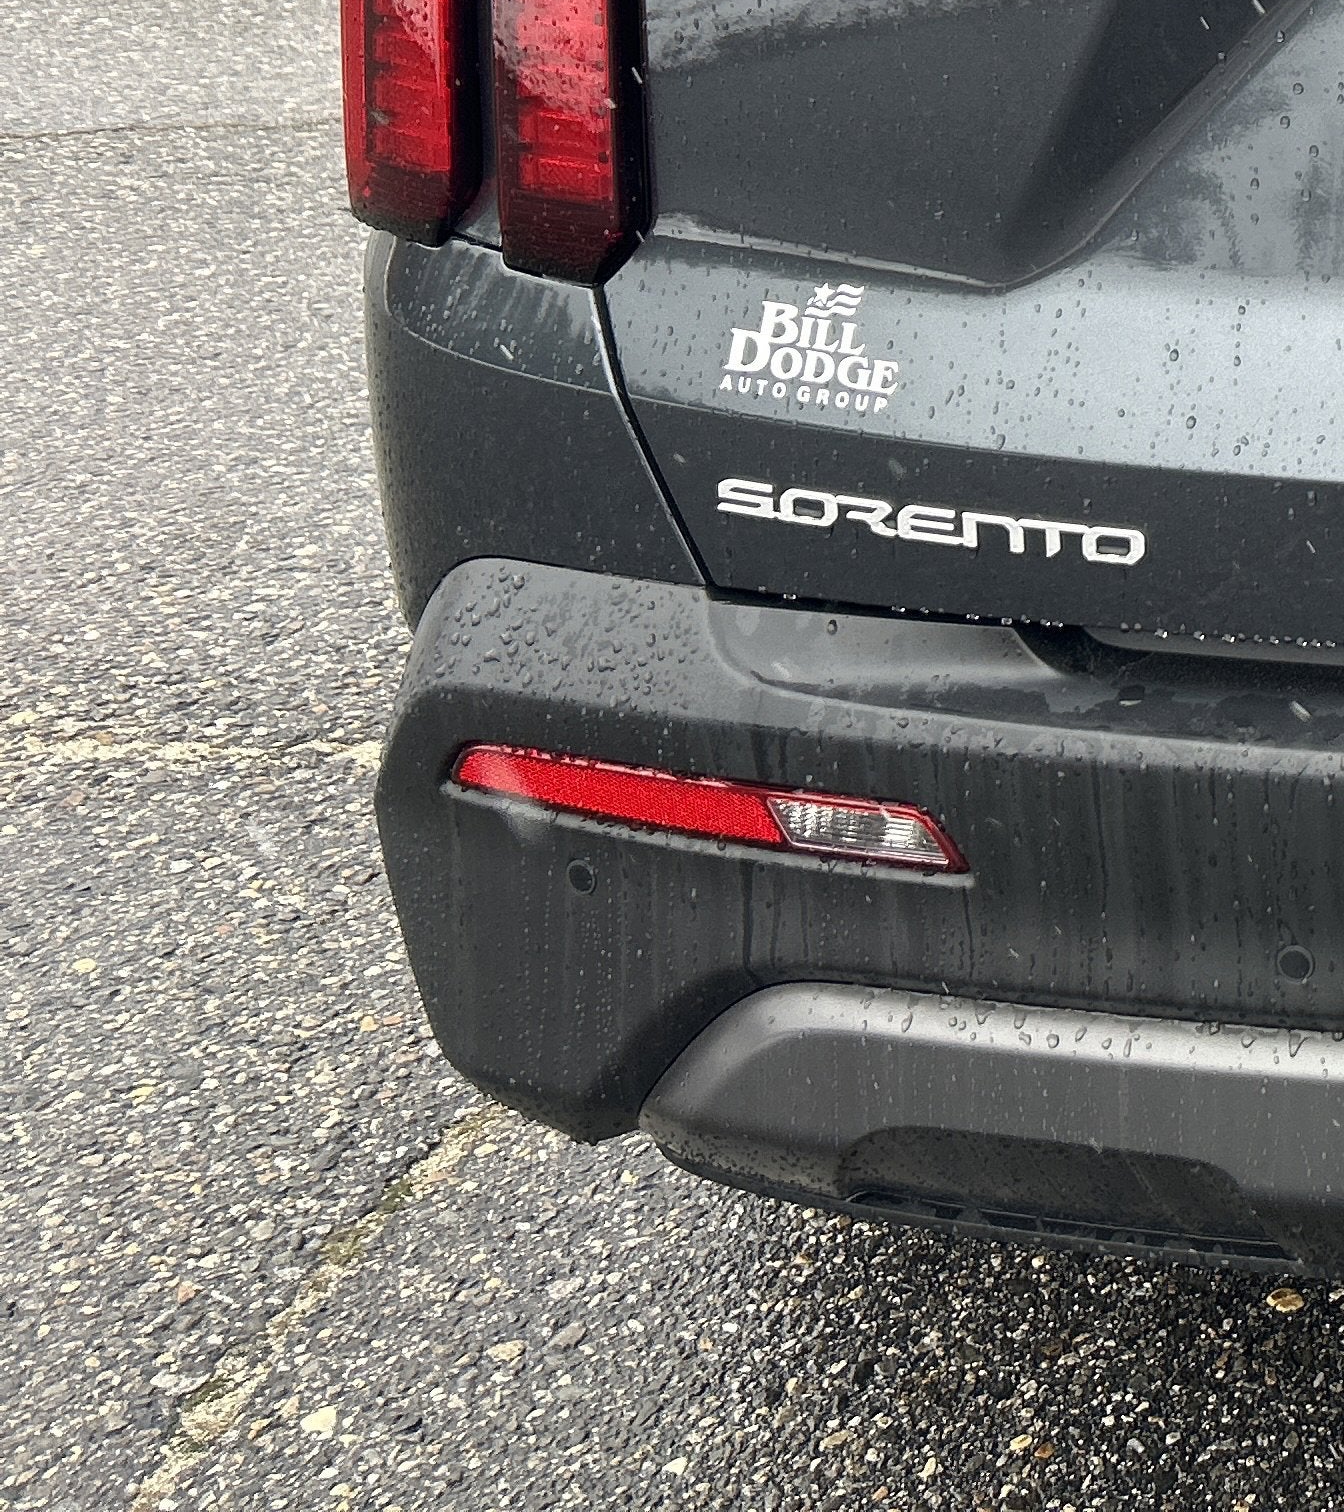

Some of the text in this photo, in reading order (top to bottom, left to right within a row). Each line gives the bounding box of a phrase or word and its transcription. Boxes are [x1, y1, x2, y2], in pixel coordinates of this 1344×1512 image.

[761, 300, 866, 356] BILL
[723, 327, 899, 395] DODGE
[718, 374, 889, 414] AUTO GROUP
[716, 478, 1146, 566] SORENTO
